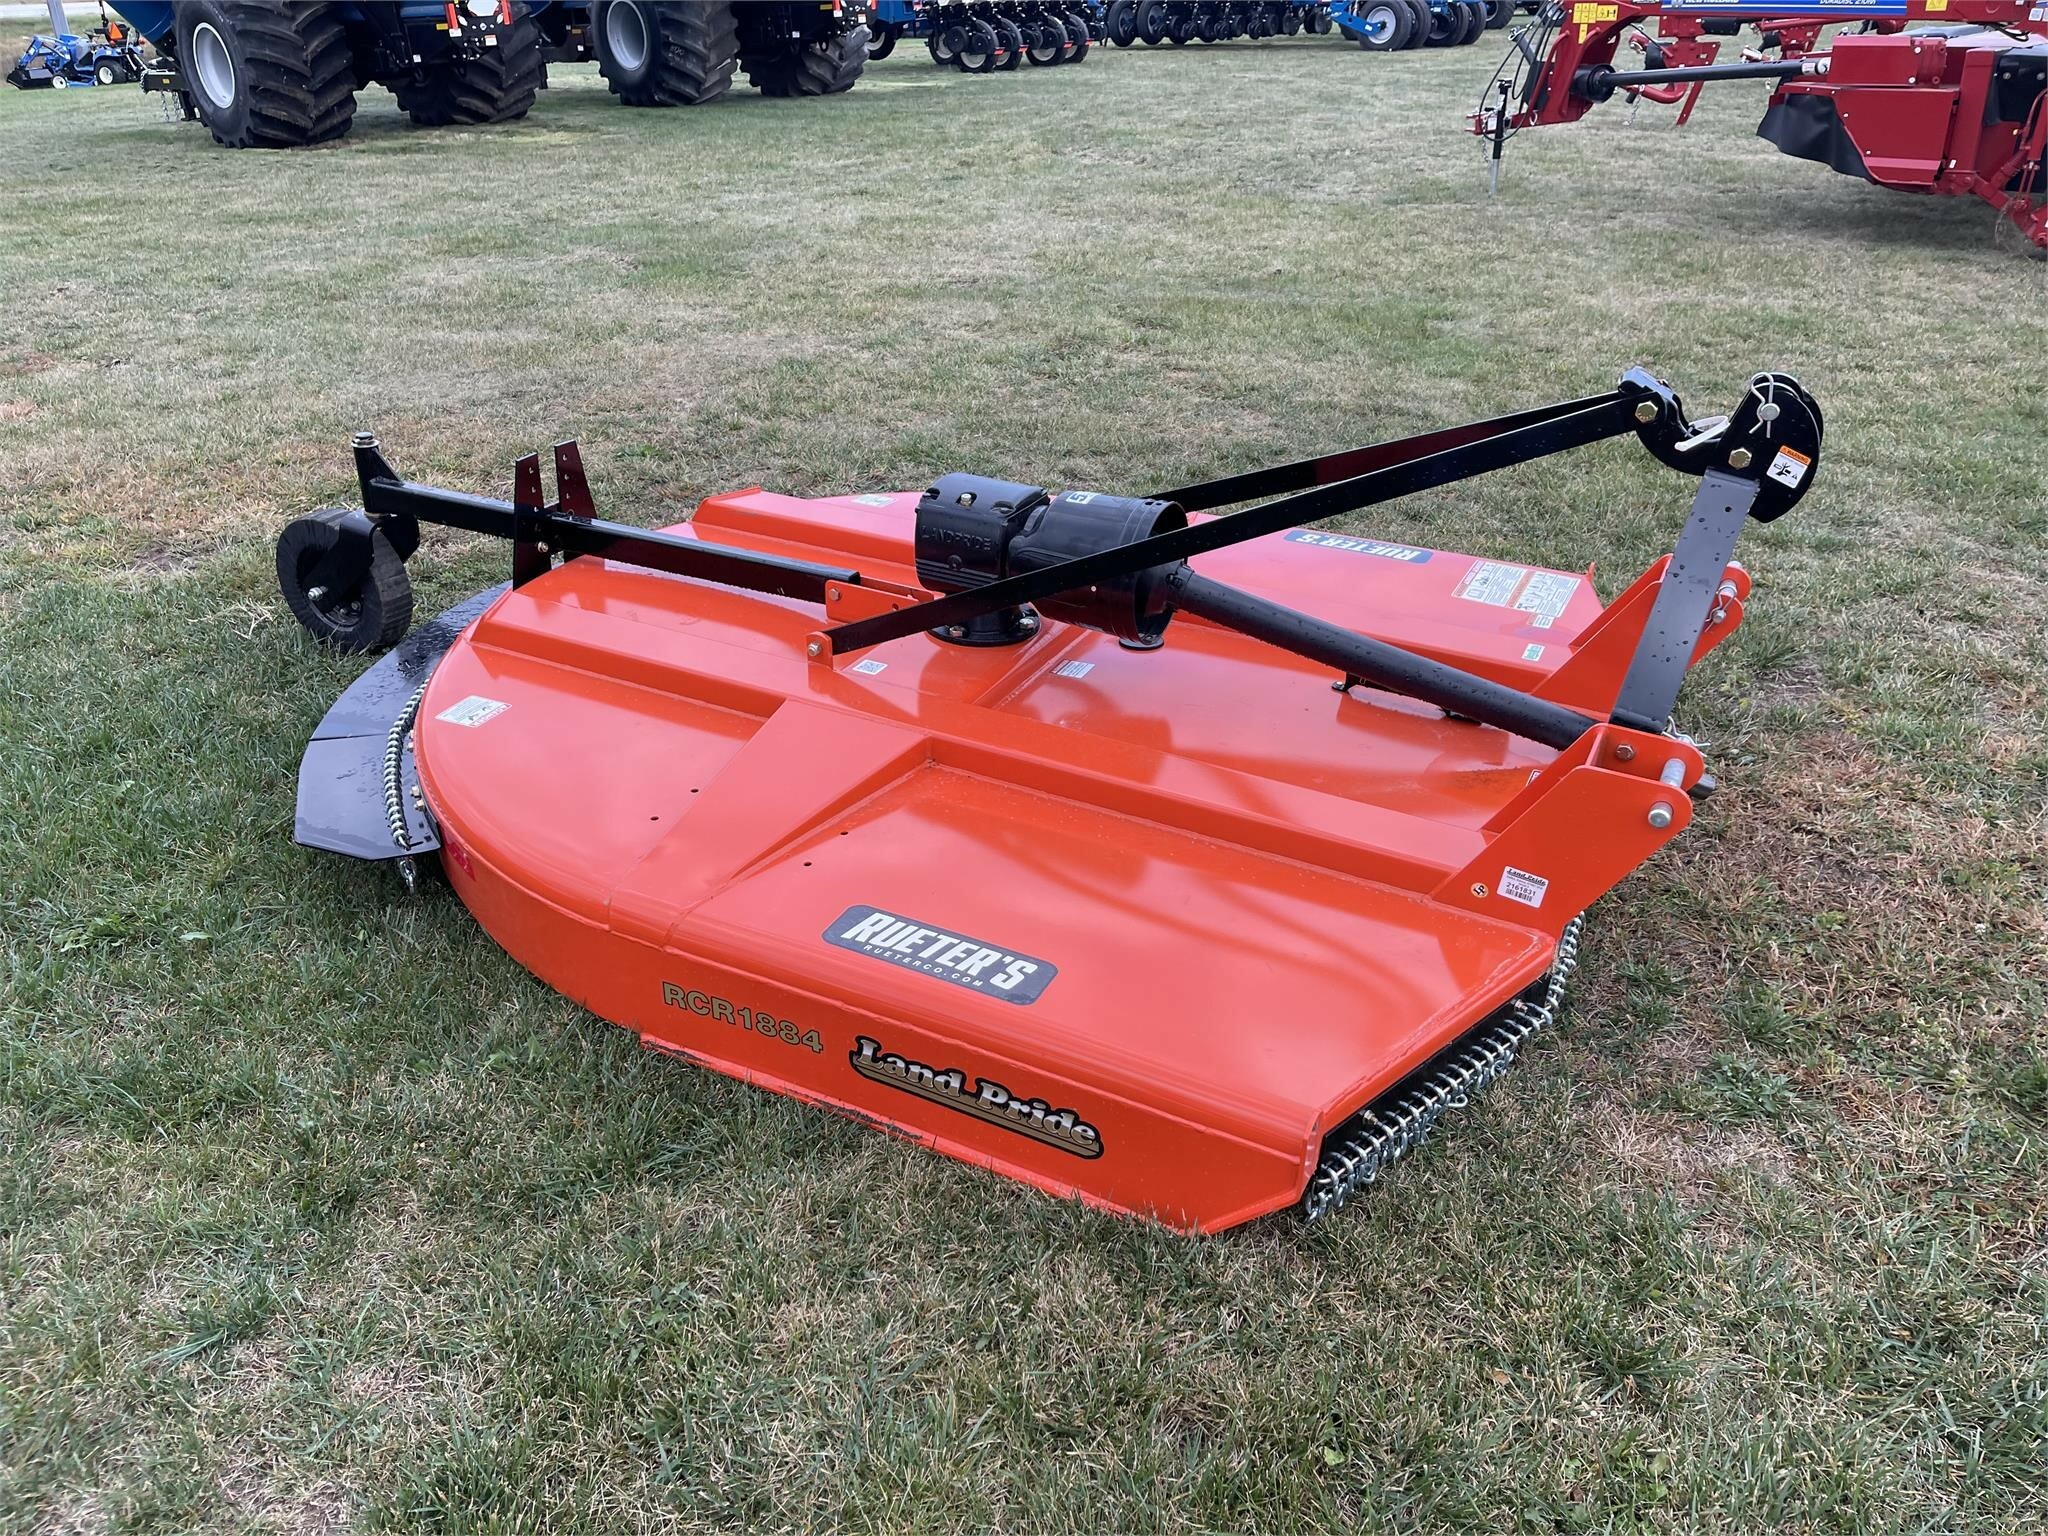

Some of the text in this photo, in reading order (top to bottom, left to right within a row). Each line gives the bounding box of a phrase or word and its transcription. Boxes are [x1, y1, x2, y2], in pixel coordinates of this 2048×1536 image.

[1295, 533, 1421, 561] RUETER'S
[840, 912, 1038, 990] RUETER'S
[863, 944, 984, 988] RUETERCO.COM
[662, 982, 824, 1054] RCR1884
[852, 1035, 1102, 1148] Land Pride
